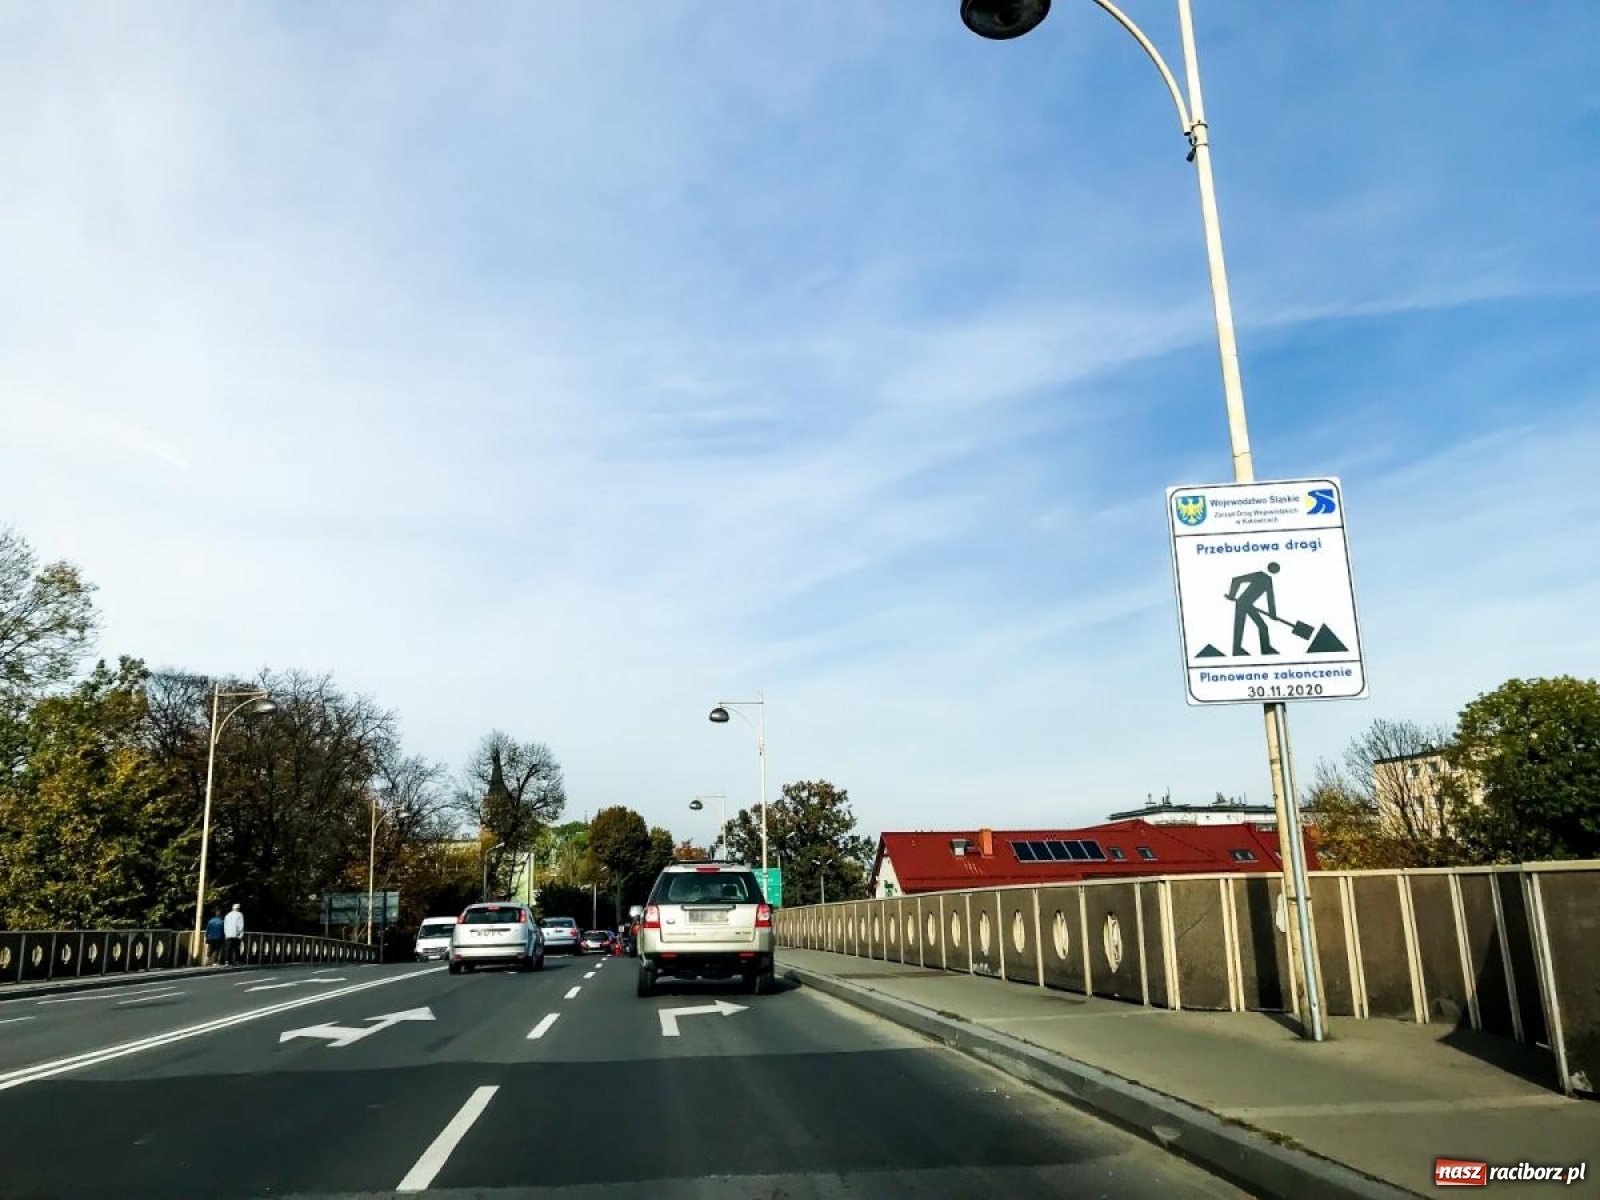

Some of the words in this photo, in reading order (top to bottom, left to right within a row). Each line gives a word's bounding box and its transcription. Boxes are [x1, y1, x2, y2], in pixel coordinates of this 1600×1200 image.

[1196, 541, 1279, 555] Przebudowa
[1285, 537, 1322, 552] drogi
[1200, 671, 1268, 682] Planowane
[1274, 667, 1353, 679] zakończenie
[1248, 683, 1323, 697] 30.11.2020
